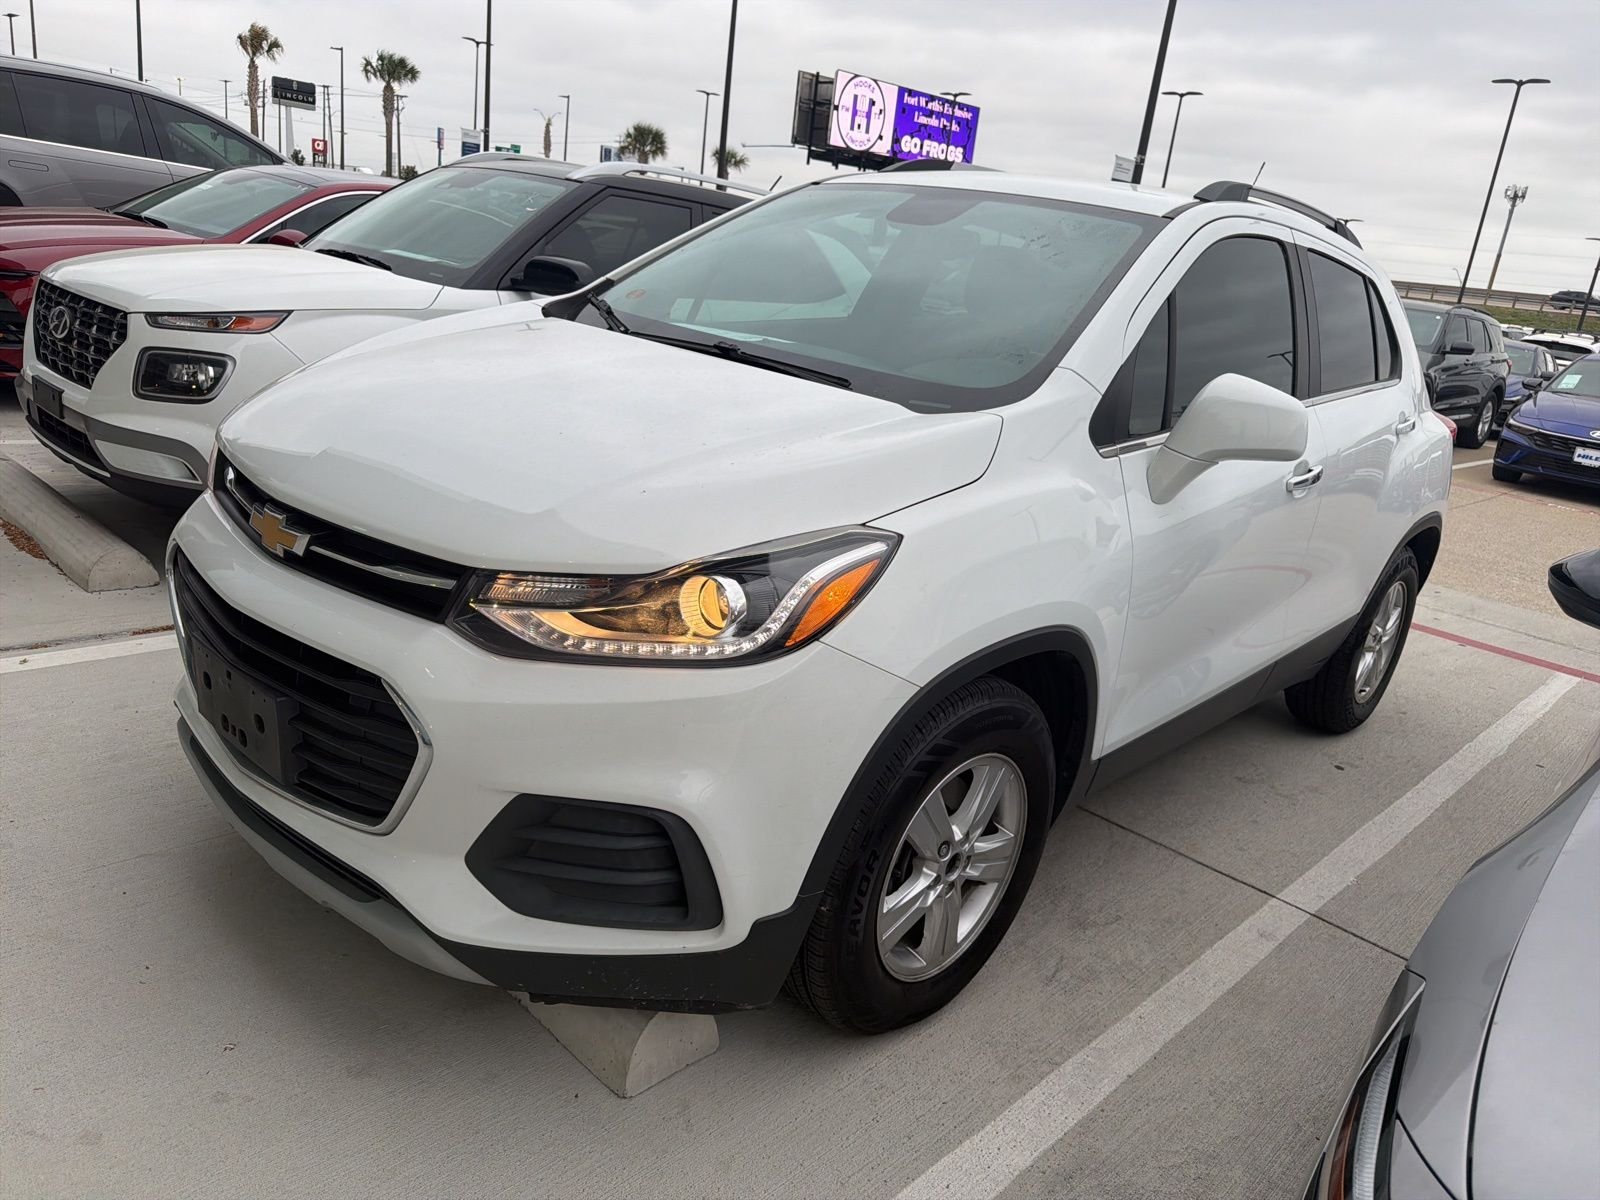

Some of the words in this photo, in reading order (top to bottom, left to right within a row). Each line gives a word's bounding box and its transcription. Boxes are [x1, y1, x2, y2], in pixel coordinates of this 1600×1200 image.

[854, 81, 875, 93] HOOKS
[904, 92, 919, 106] Fort
[901, 135, 921, 154] GO
[922, 139, 964, 163] FROGS
